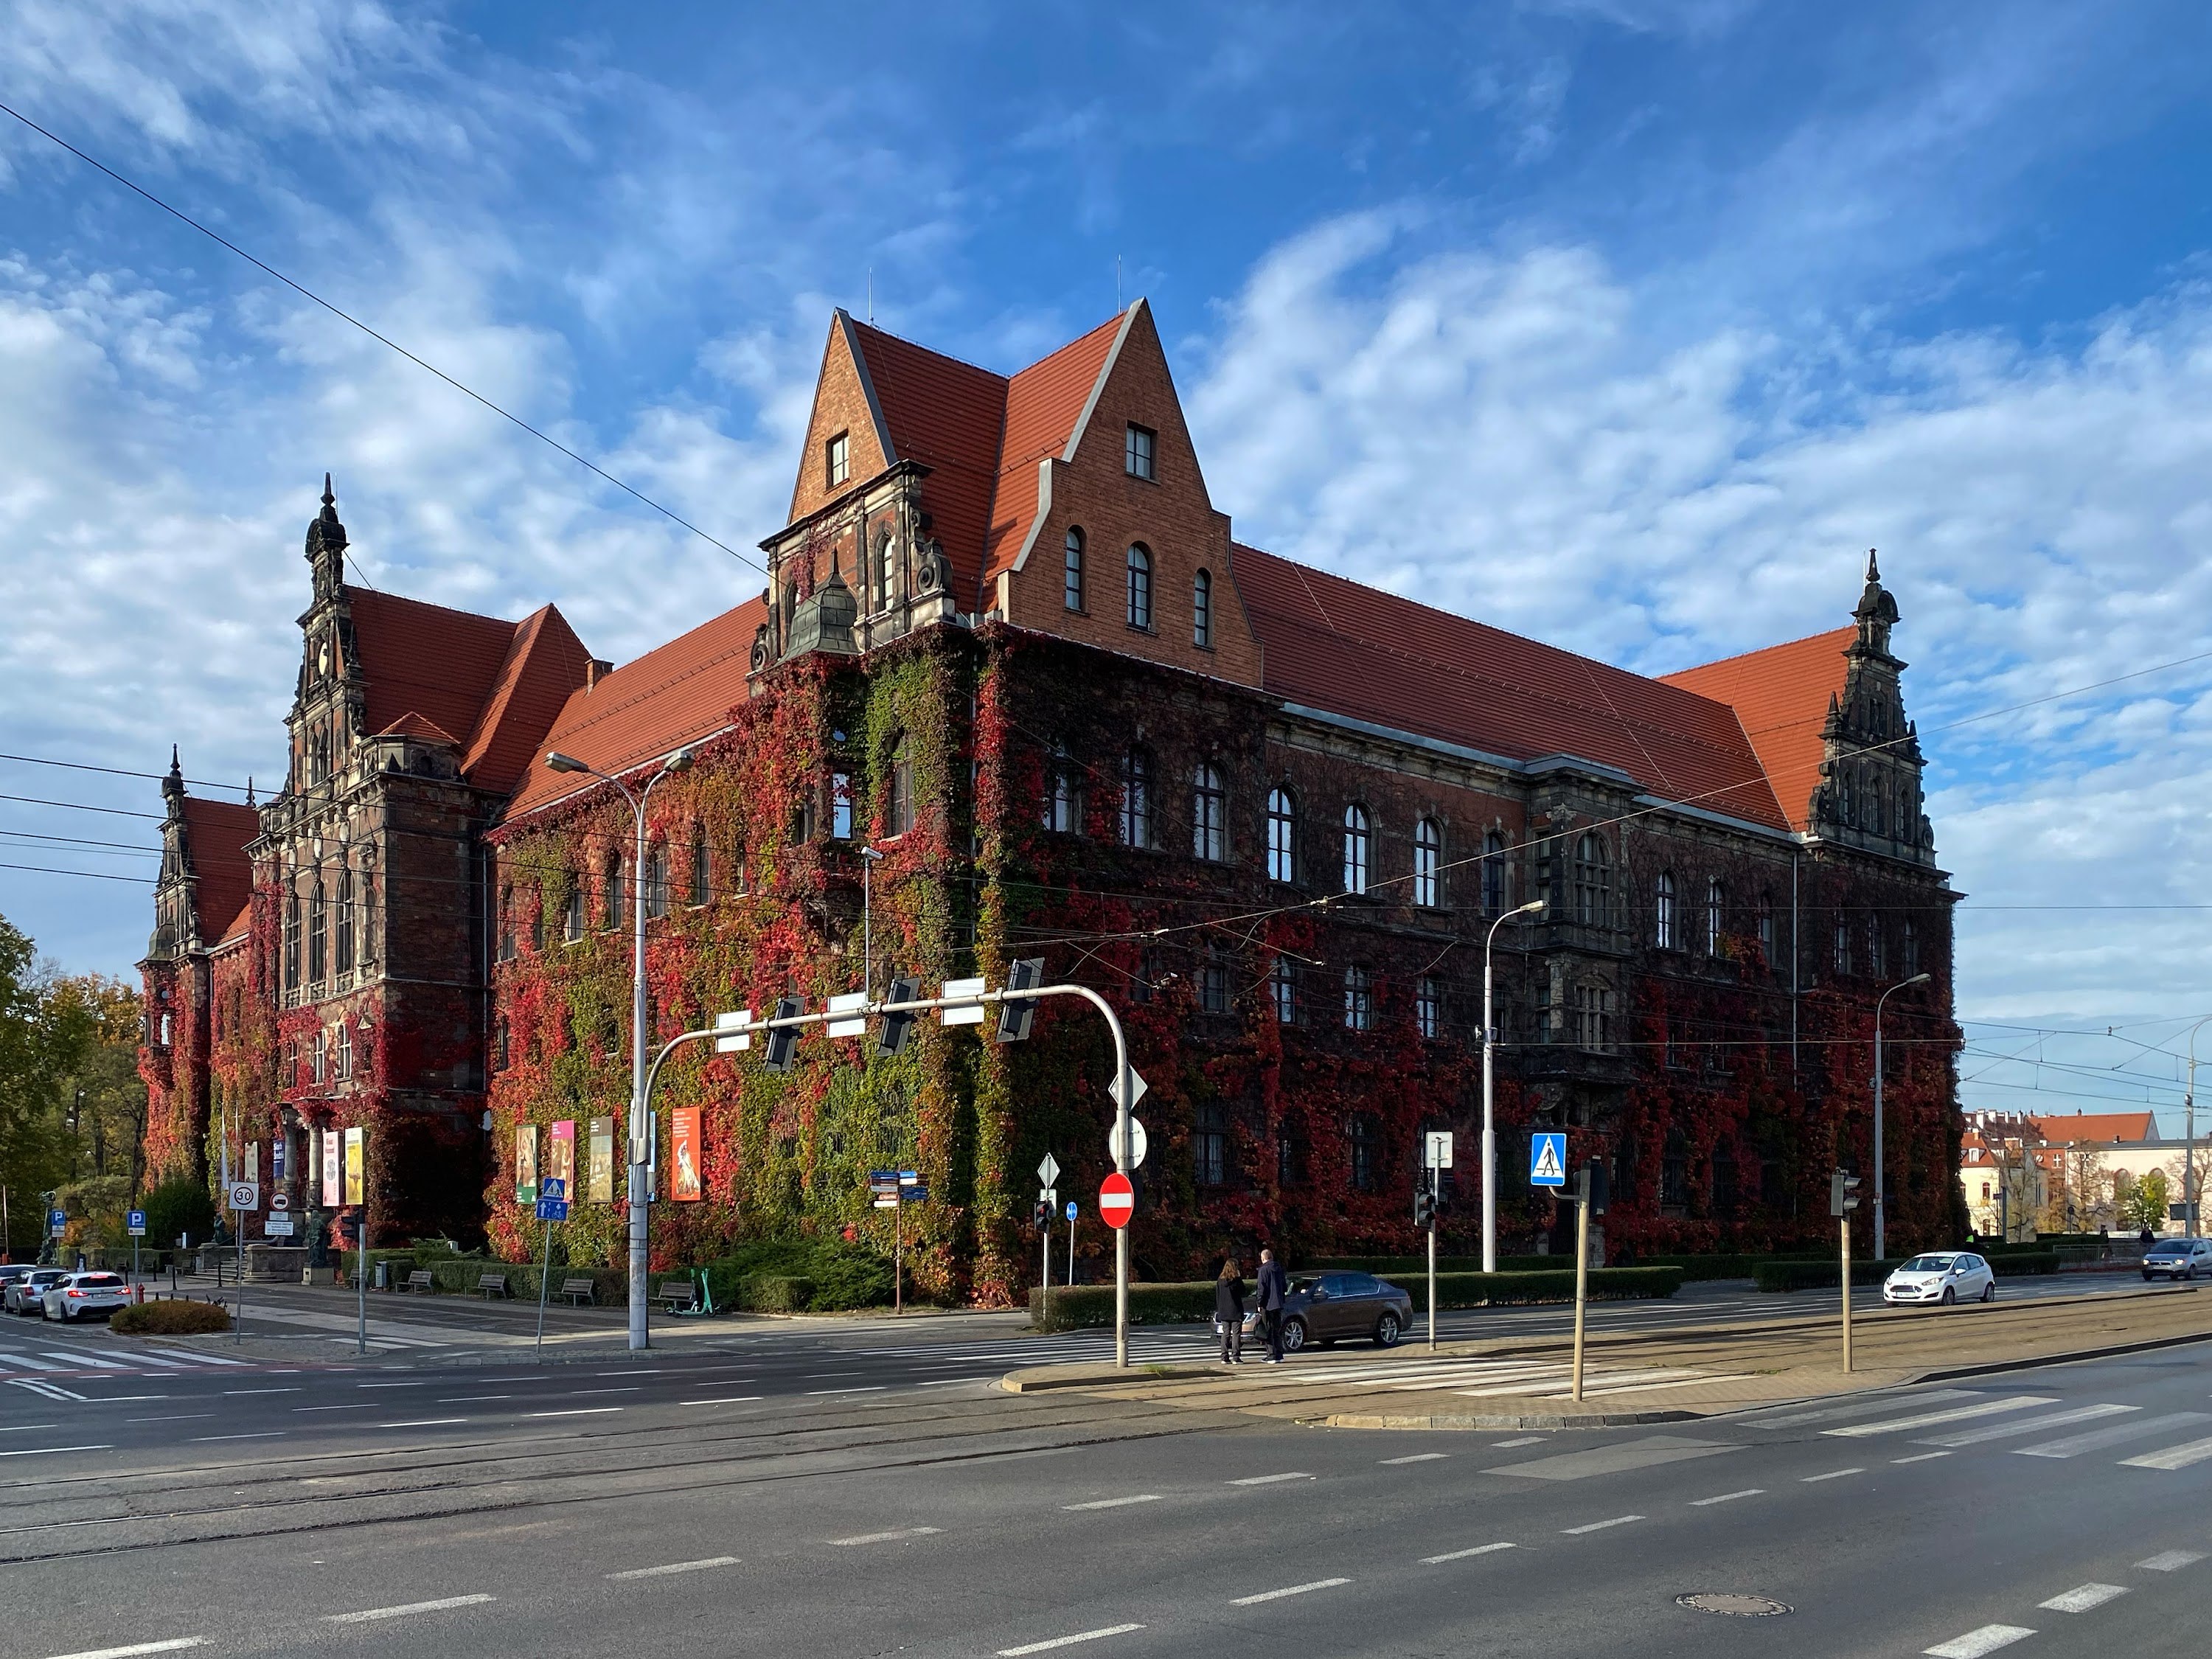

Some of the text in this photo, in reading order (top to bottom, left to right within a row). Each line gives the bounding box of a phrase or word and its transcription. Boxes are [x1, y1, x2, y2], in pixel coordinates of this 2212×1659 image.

[237, 1191, 251, 1200] 30
[55, 1211, 63, 1221] P
[132, 1213, 142, 1225] P
